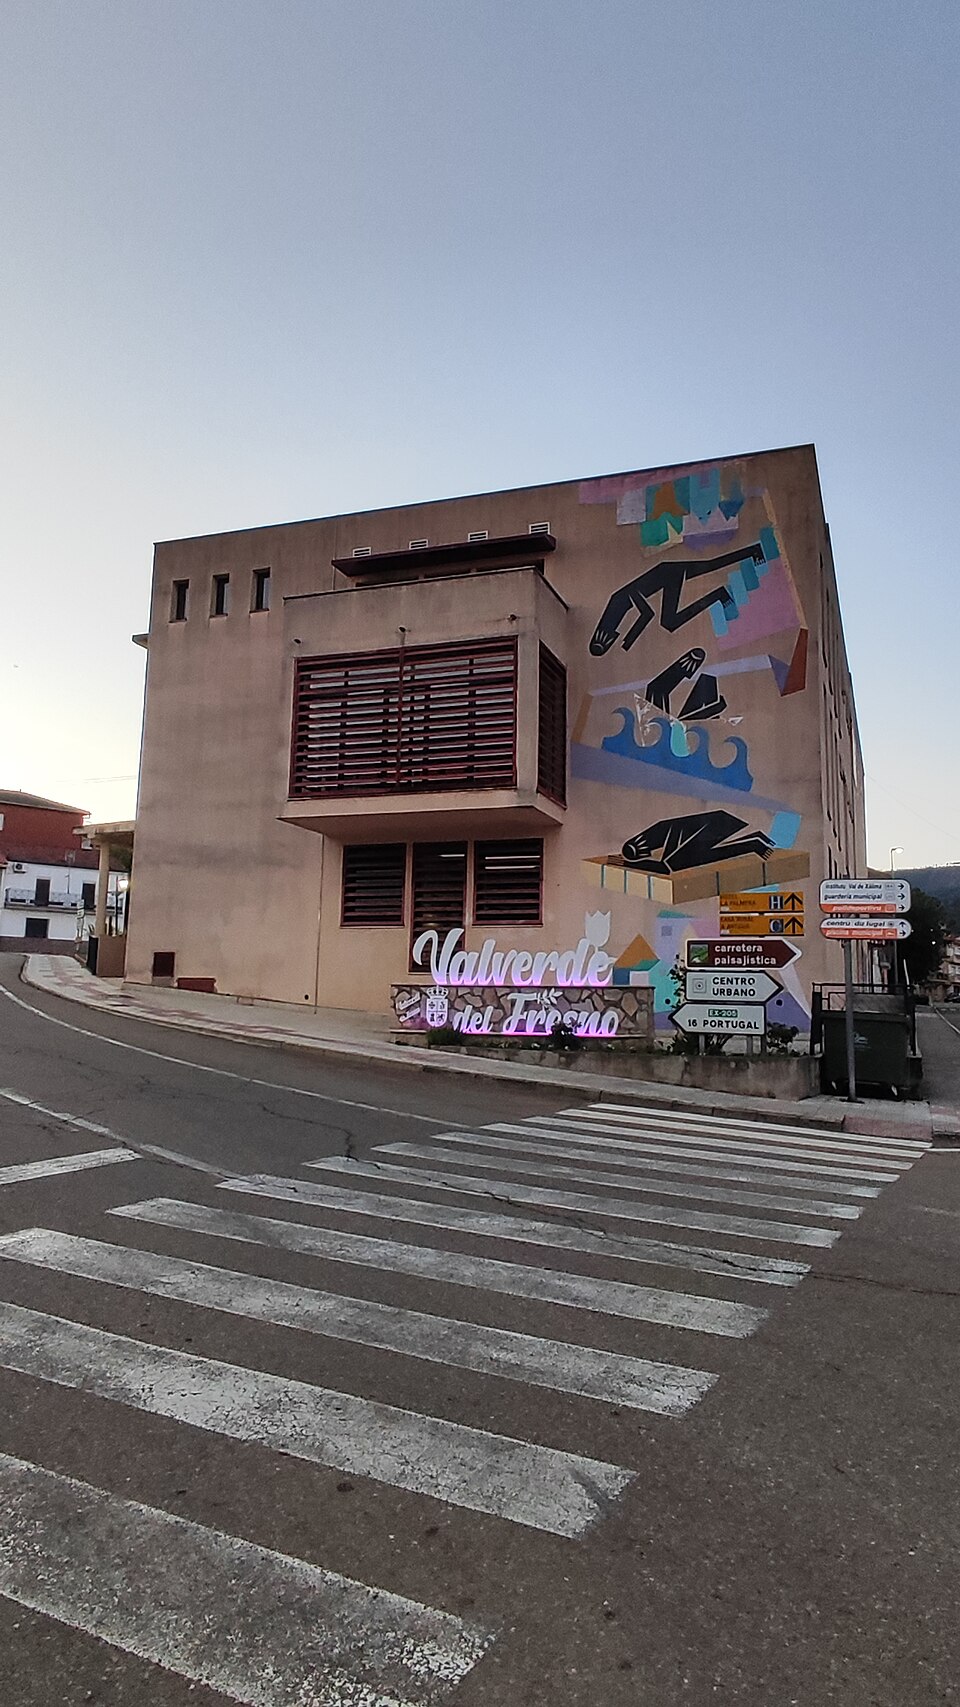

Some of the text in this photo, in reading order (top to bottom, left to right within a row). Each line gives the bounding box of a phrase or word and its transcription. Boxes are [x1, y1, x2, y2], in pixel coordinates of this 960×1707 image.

[714, 943, 763, 953] carretera
[412, 928, 617, 987] Valverde
[714, 955, 777, 966] paisajística
[712, 976, 756, 986] CENTRO
[712, 987, 756, 997] URBANO
[453, 1004, 494, 1034] del
[502, 992, 619, 1036] Fresno
[709, 1009, 738, 1017] EX-205
[687, 1019, 759, 1030] 16 PORTUGAL
